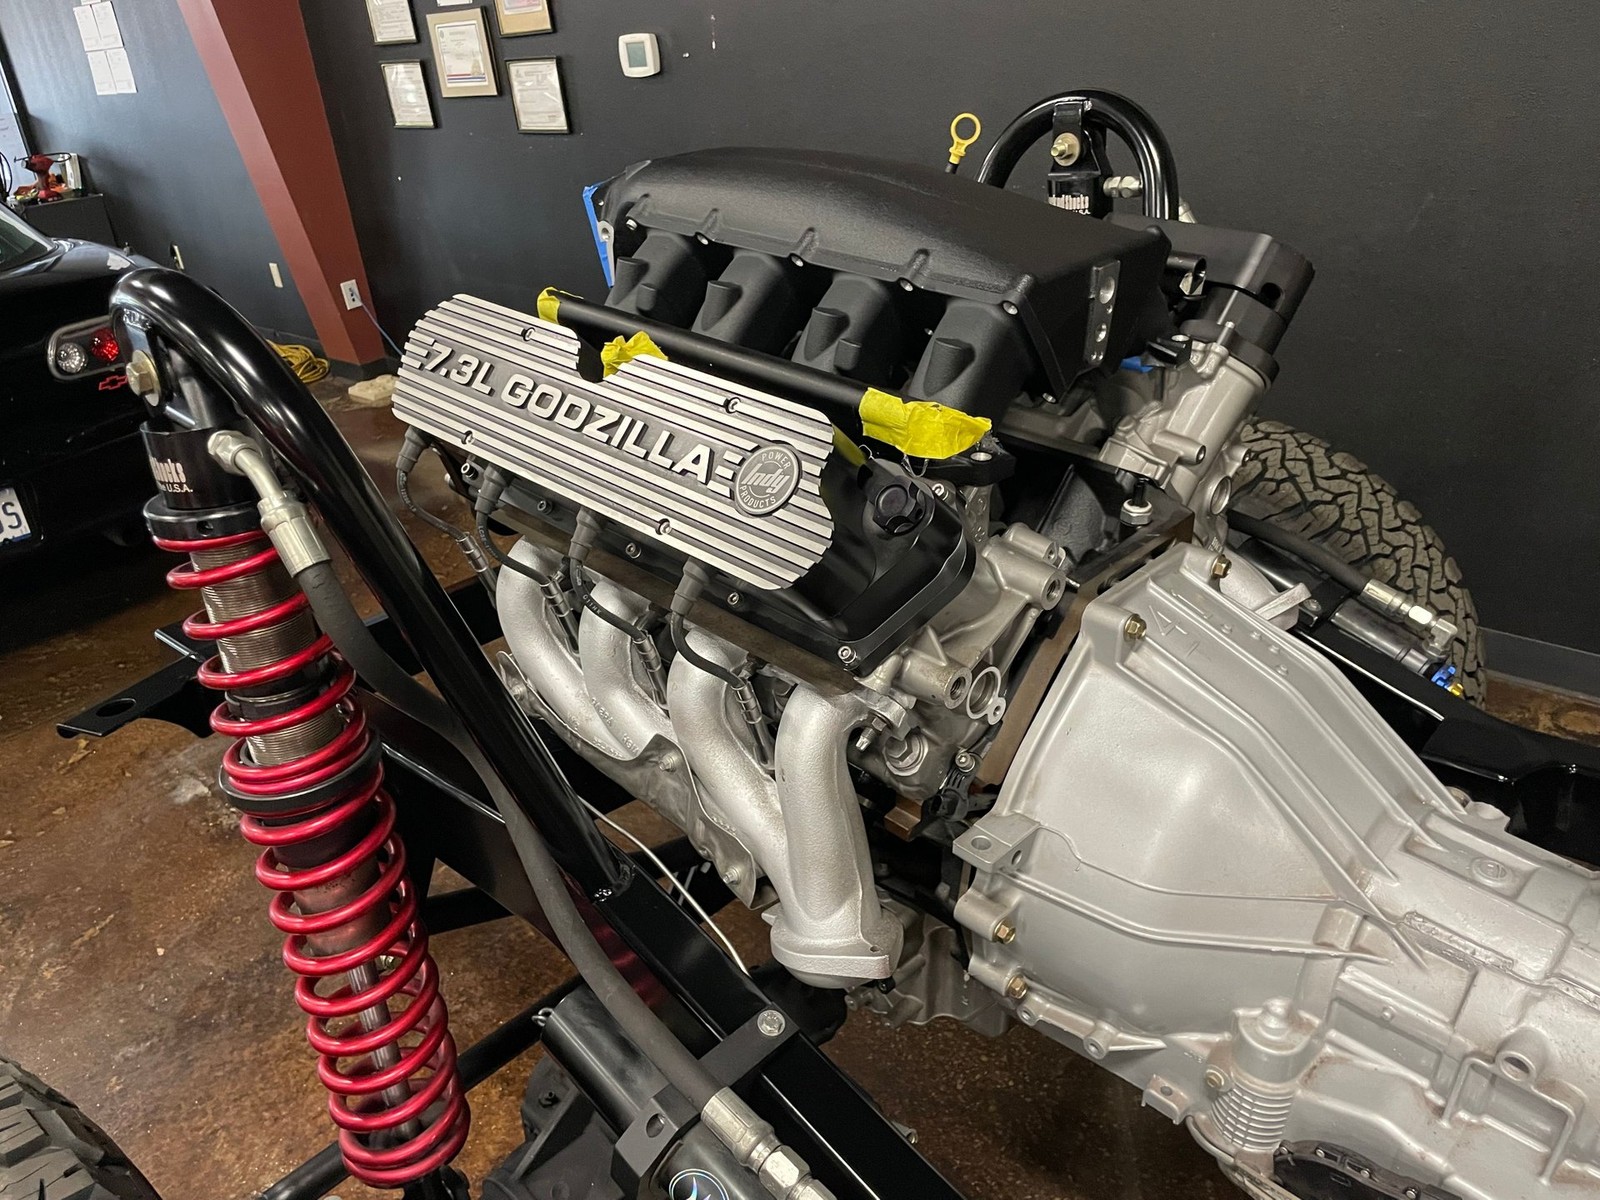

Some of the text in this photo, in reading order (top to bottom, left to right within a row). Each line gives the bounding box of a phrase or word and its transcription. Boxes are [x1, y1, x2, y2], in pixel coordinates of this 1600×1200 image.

[425, 342, 713, 484] 7.3L GODZILLA
[761, 451, 791, 470] POWER
[166, 484, 193, 493] U.S.A.
[741, 463, 790, 494] Indy
[740, 485, 776, 508] PRODUCTS
[0, 501, 22, 533] S
